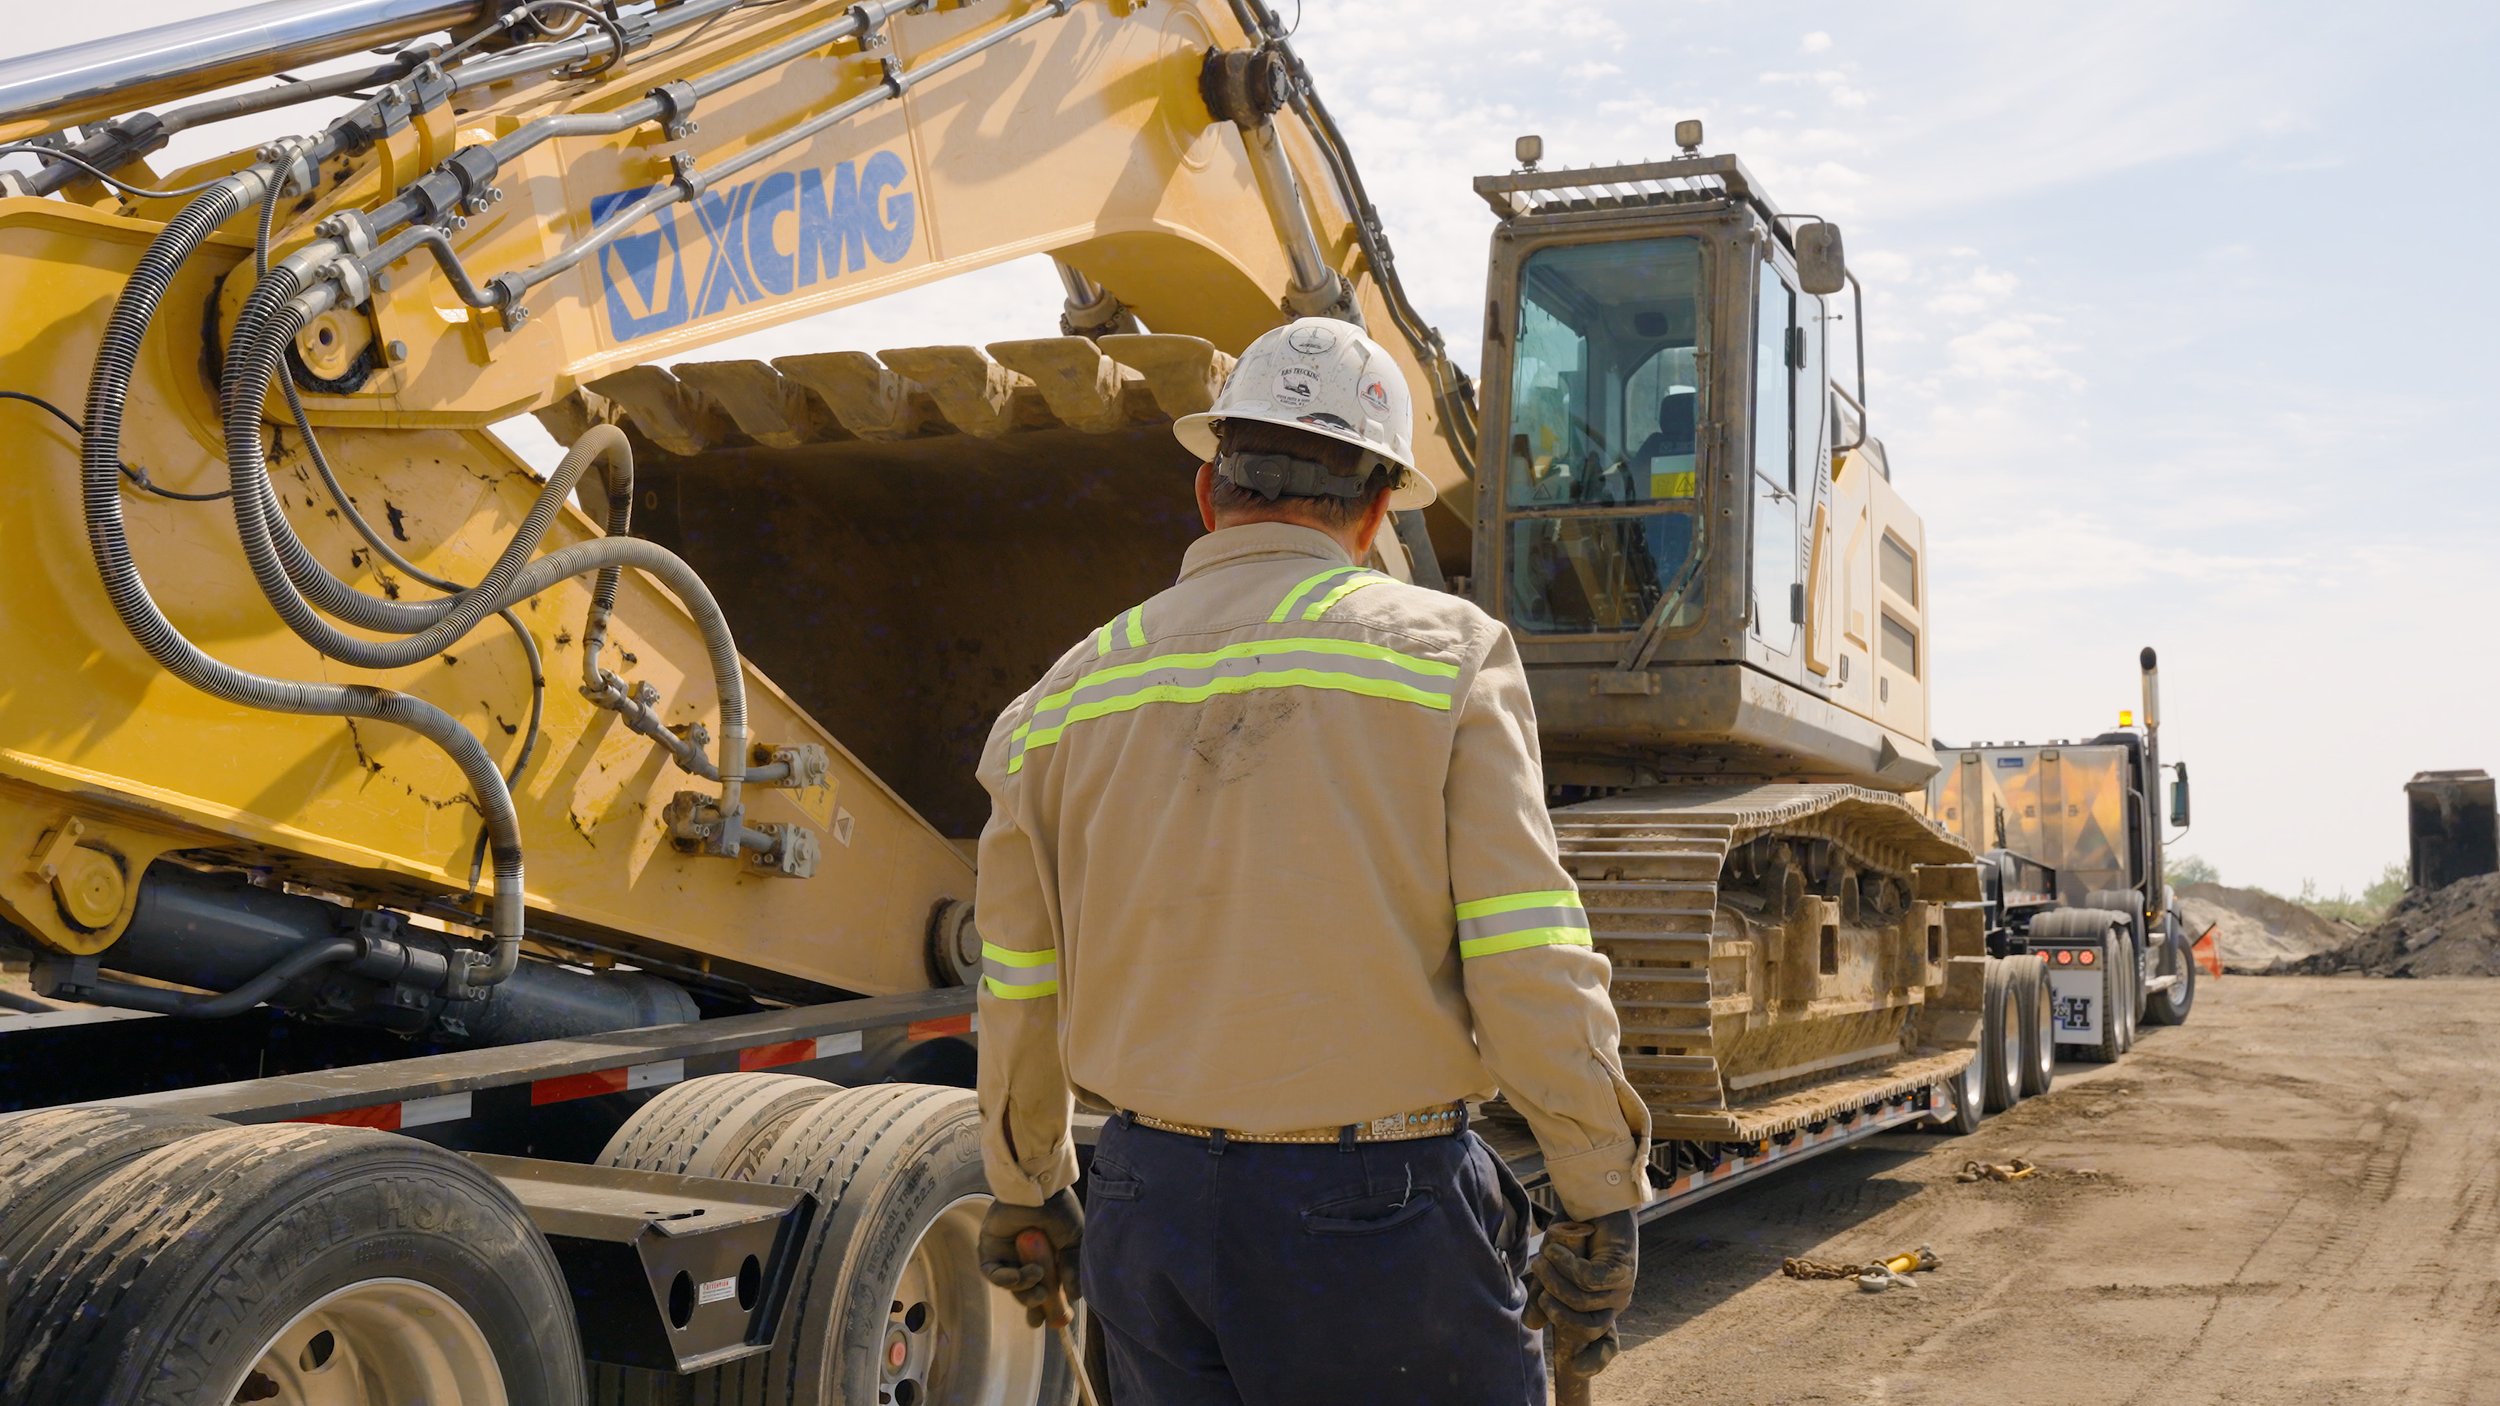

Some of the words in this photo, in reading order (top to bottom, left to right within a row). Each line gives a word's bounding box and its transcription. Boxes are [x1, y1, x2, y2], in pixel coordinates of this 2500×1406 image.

[691, 151, 915, 319] XCMG
[1293, 367, 1320, 382] TRUCKING
[877, 1222, 908, 1284] 275/70
[912, 1178, 937, 1211] 22.5
